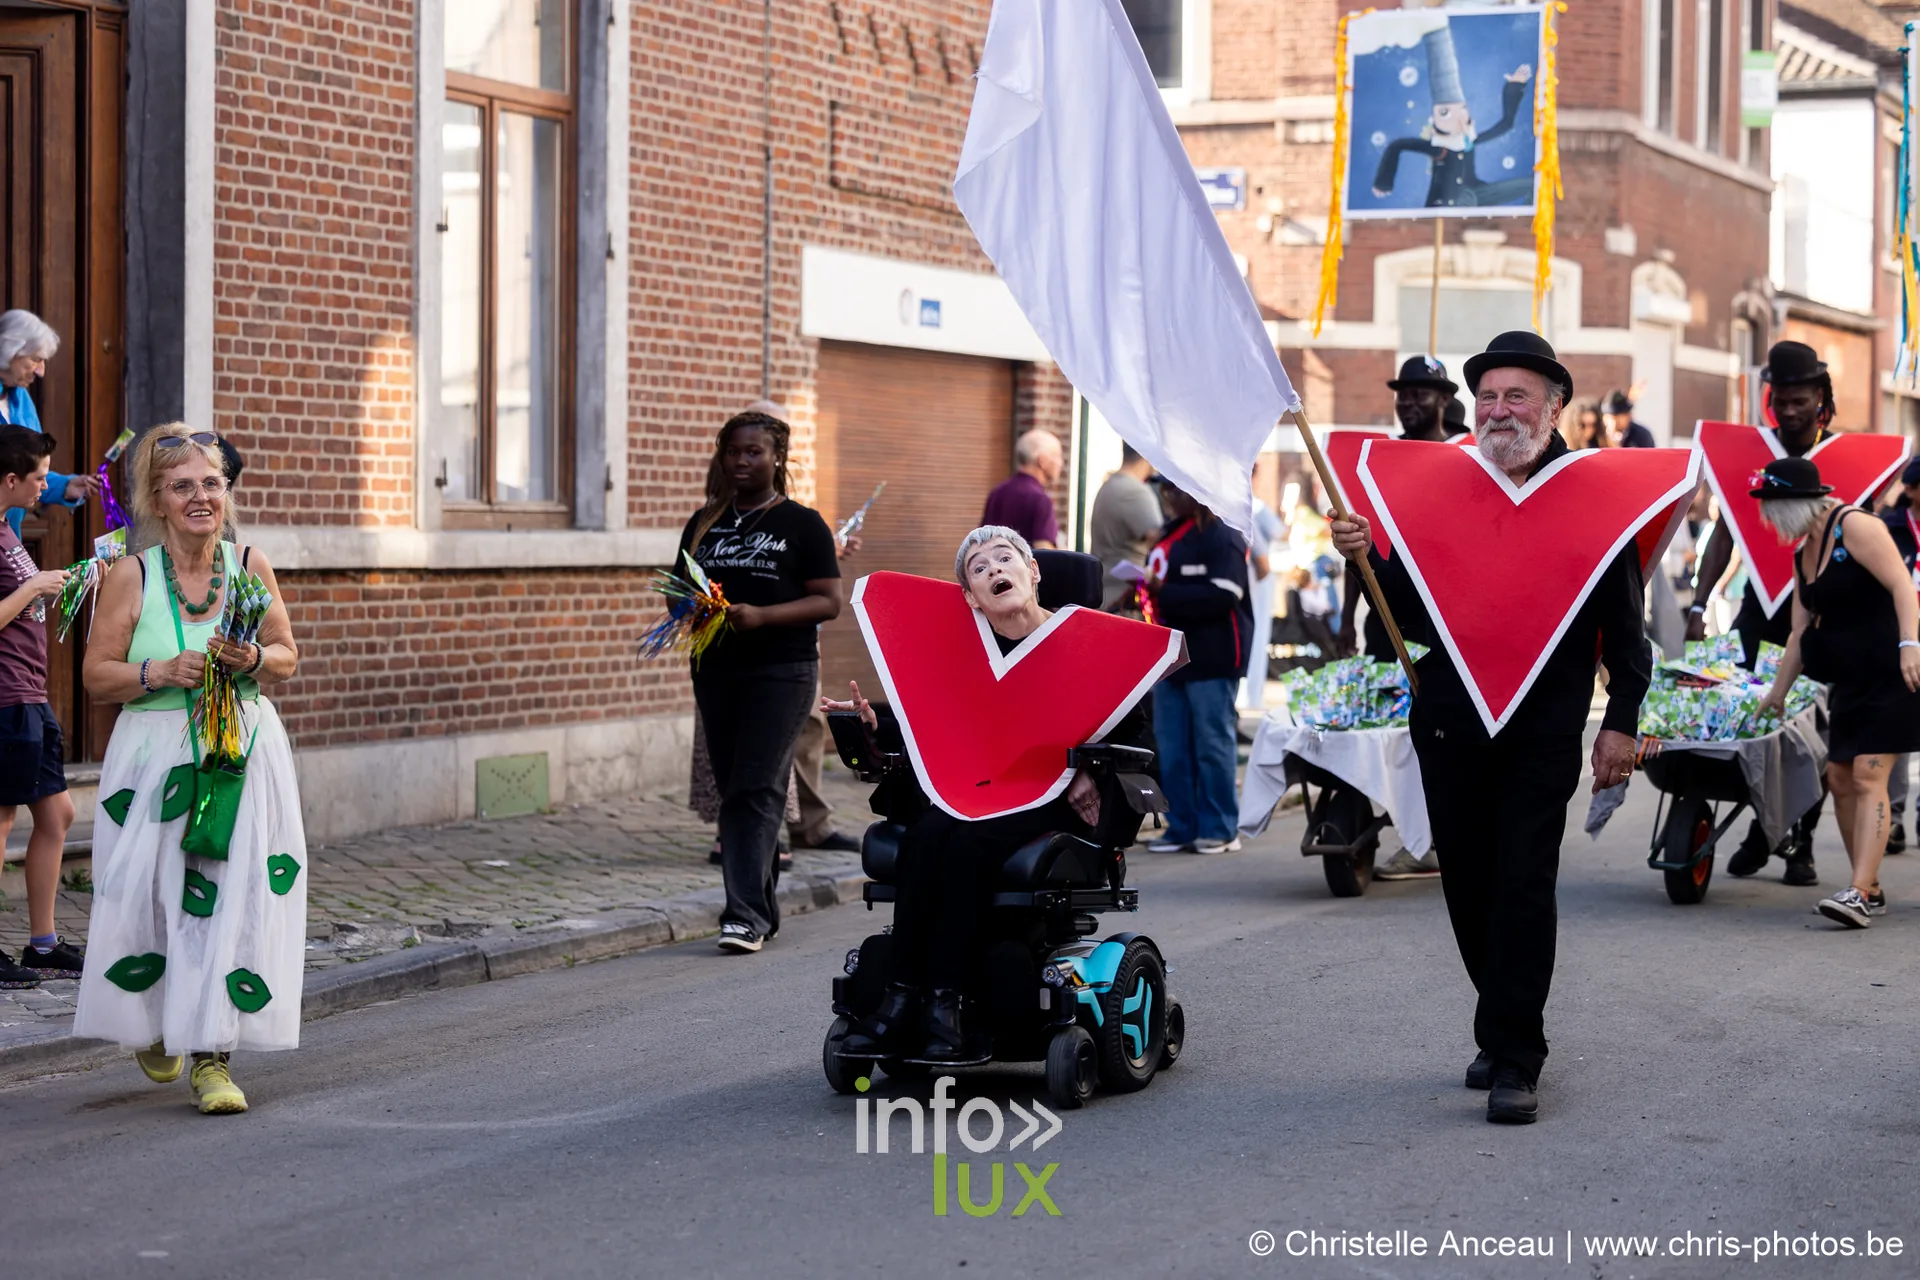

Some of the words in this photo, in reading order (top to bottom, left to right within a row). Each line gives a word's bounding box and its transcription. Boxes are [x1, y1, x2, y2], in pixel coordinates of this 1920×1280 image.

[697, 535, 743, 561] New
[739, 531, 787, 561] York
[703, 559, 715, 568] OR
[716, 559, 755, 568] NOWHERE
[756, 560, 777, 570] ELSE
